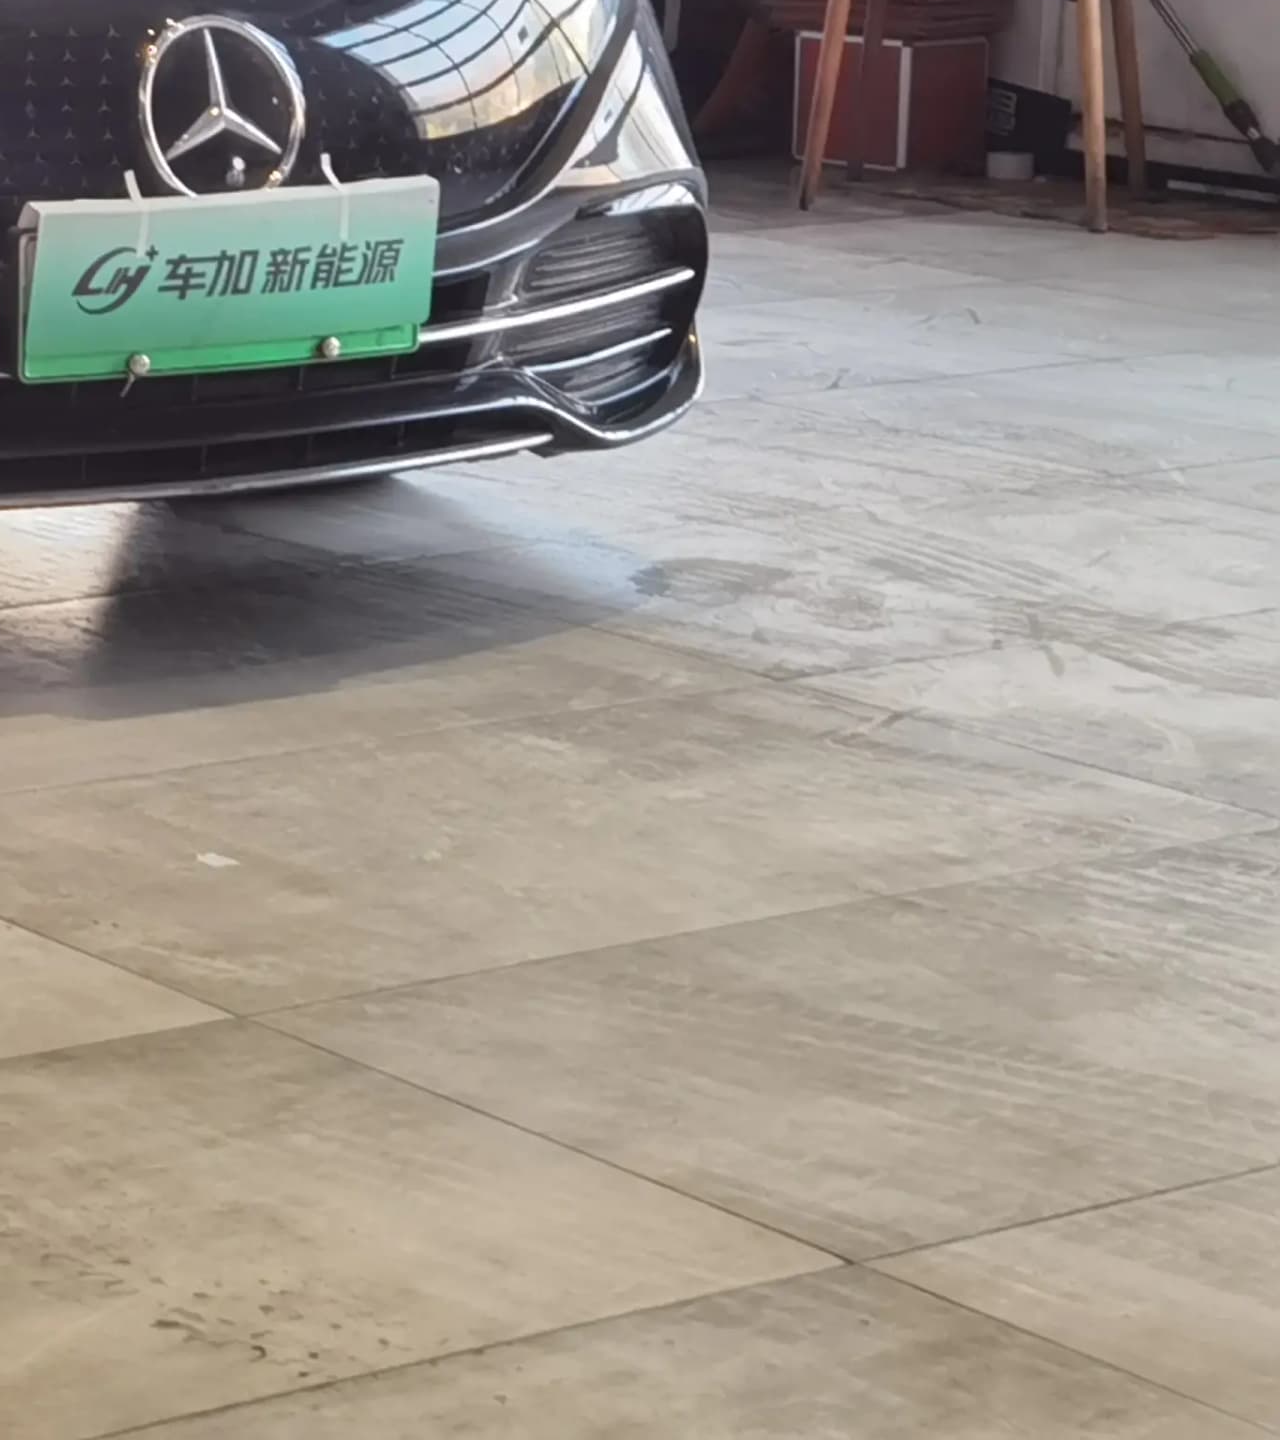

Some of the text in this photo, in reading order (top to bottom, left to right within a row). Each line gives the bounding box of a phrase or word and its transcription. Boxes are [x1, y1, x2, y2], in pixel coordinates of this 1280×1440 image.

[157, 238, 405, 301] 车加新能源
